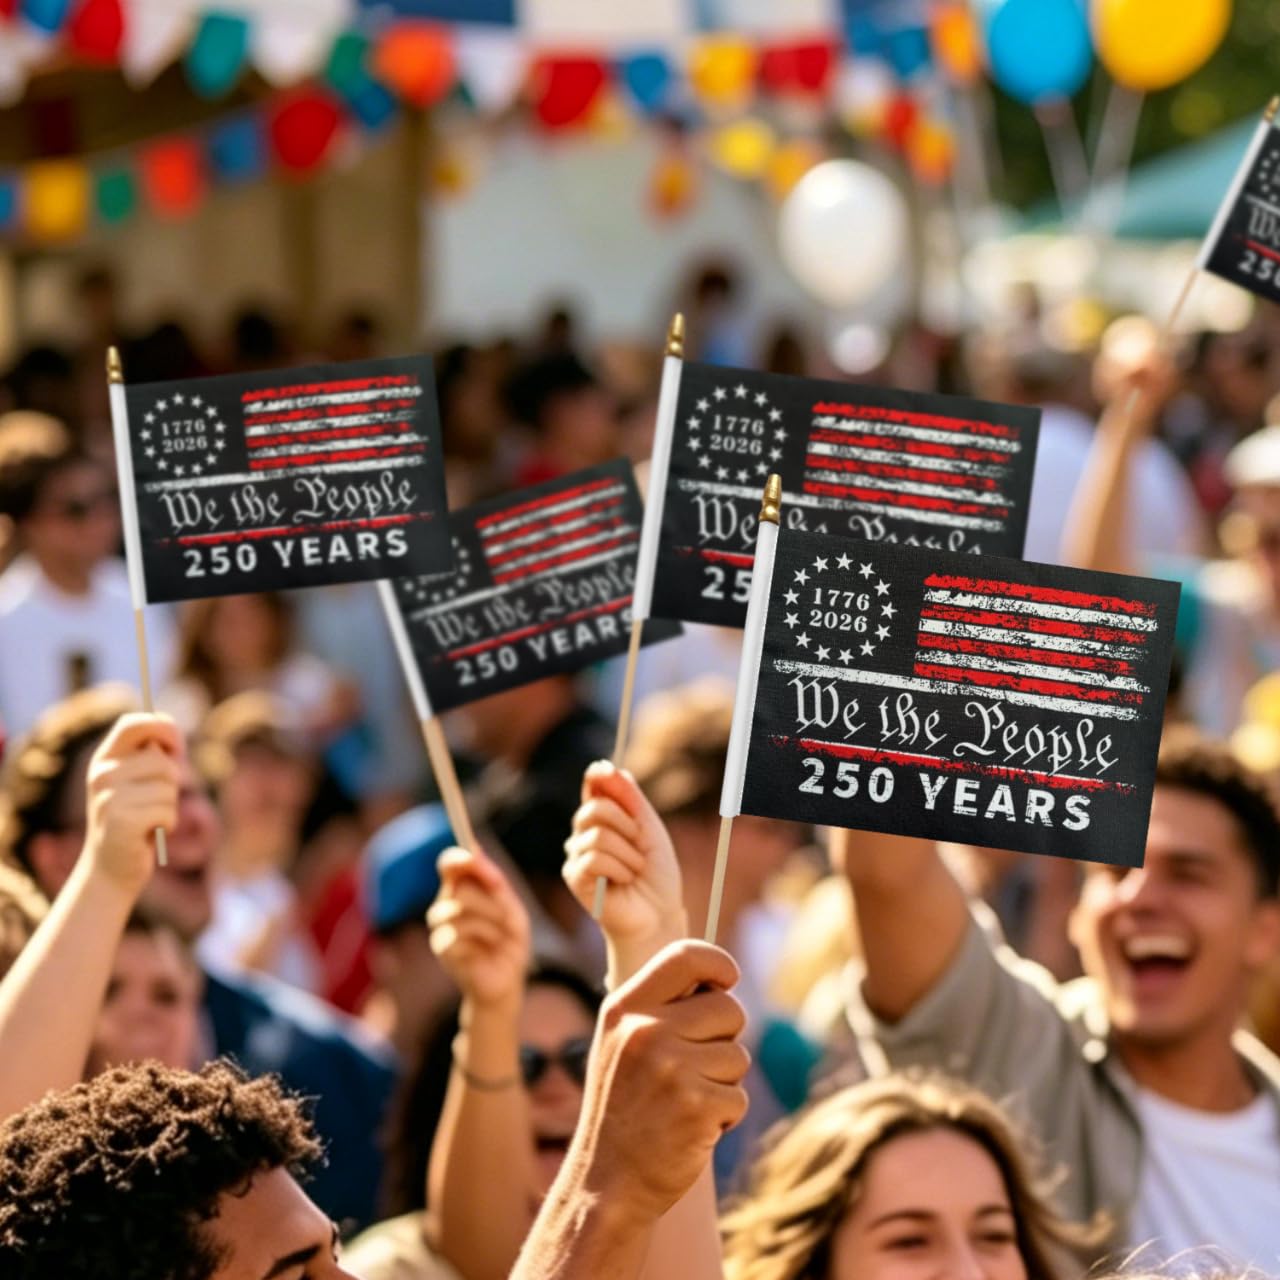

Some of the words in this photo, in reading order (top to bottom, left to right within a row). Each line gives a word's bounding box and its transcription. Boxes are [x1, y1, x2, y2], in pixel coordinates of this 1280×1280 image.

[161, 419, 206, 436] 1776
[712, 414, 765, 435] 1776
[162, 436, 208, 453] 2026
[709, 435, 762, 455] 2026
[159, 489, 225, 534] We
[229, 484, 285, 524] the
[292, 471, 418, 523] People
[692, 495, 759, 550] We
[184, 543, 257, 578] 250
[272, 529, 409, 568] YEARS
[701, 566, 753, 602] 25
[812, 587, 871, 611] 1776
[809, 609, 868, 633] 2026
[787, 673, 866, 739] We
[877, 692, 948, 750] the
[952, 701, 1119, 777] People
[798, 757, 895, 803] 250
[919, 773, 1091, 831] YEARS
